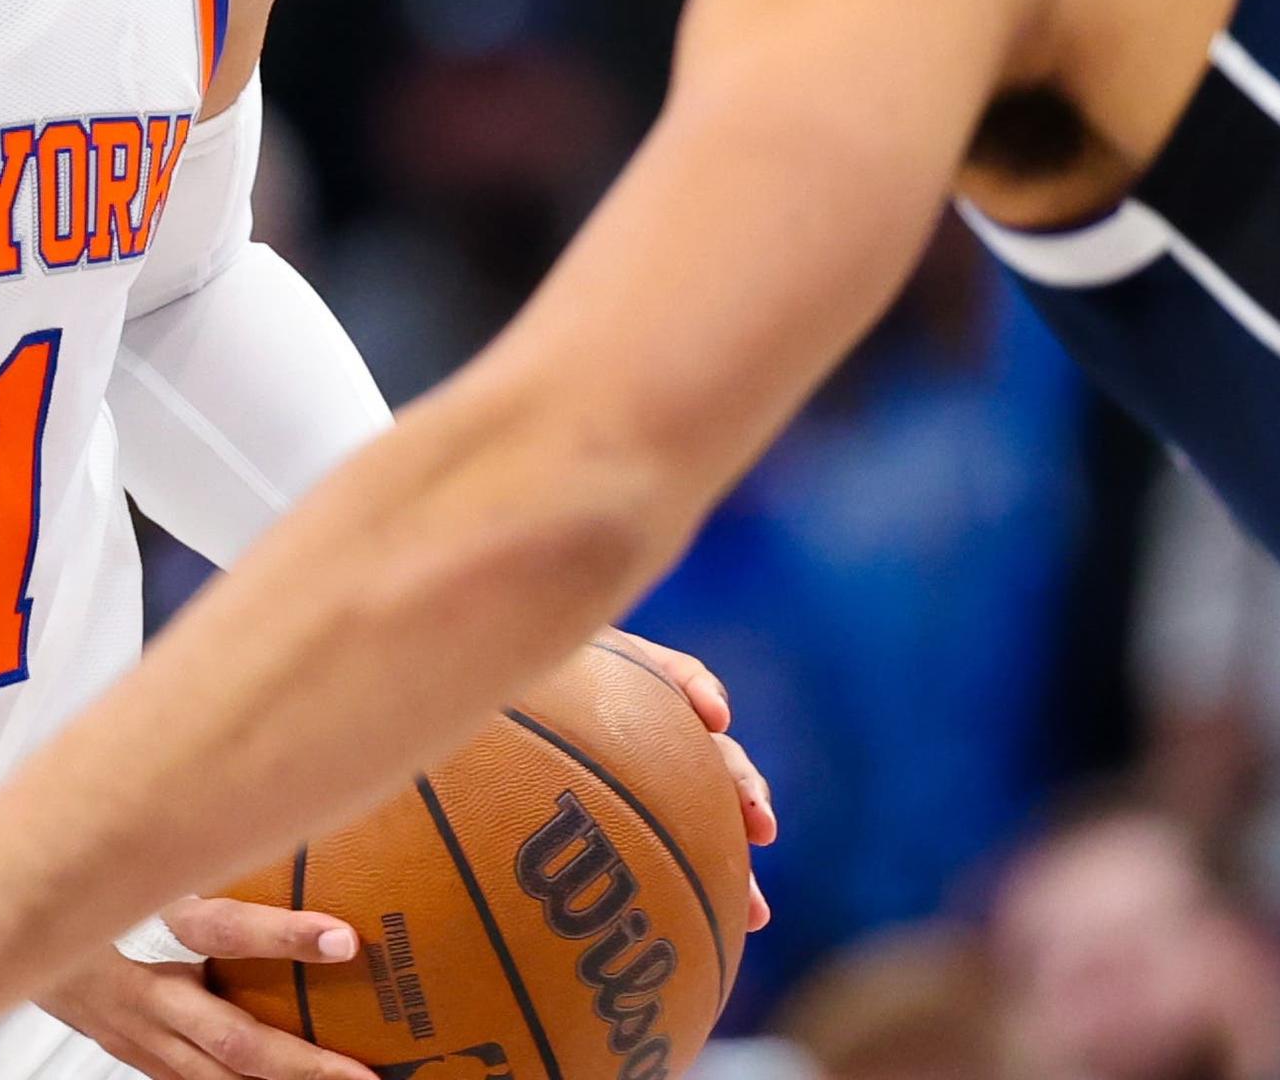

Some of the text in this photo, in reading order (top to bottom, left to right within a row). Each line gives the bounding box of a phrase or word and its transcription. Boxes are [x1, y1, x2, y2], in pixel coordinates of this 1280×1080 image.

[381, 912, 435, 1041] OFFICIAL GAME BALL
